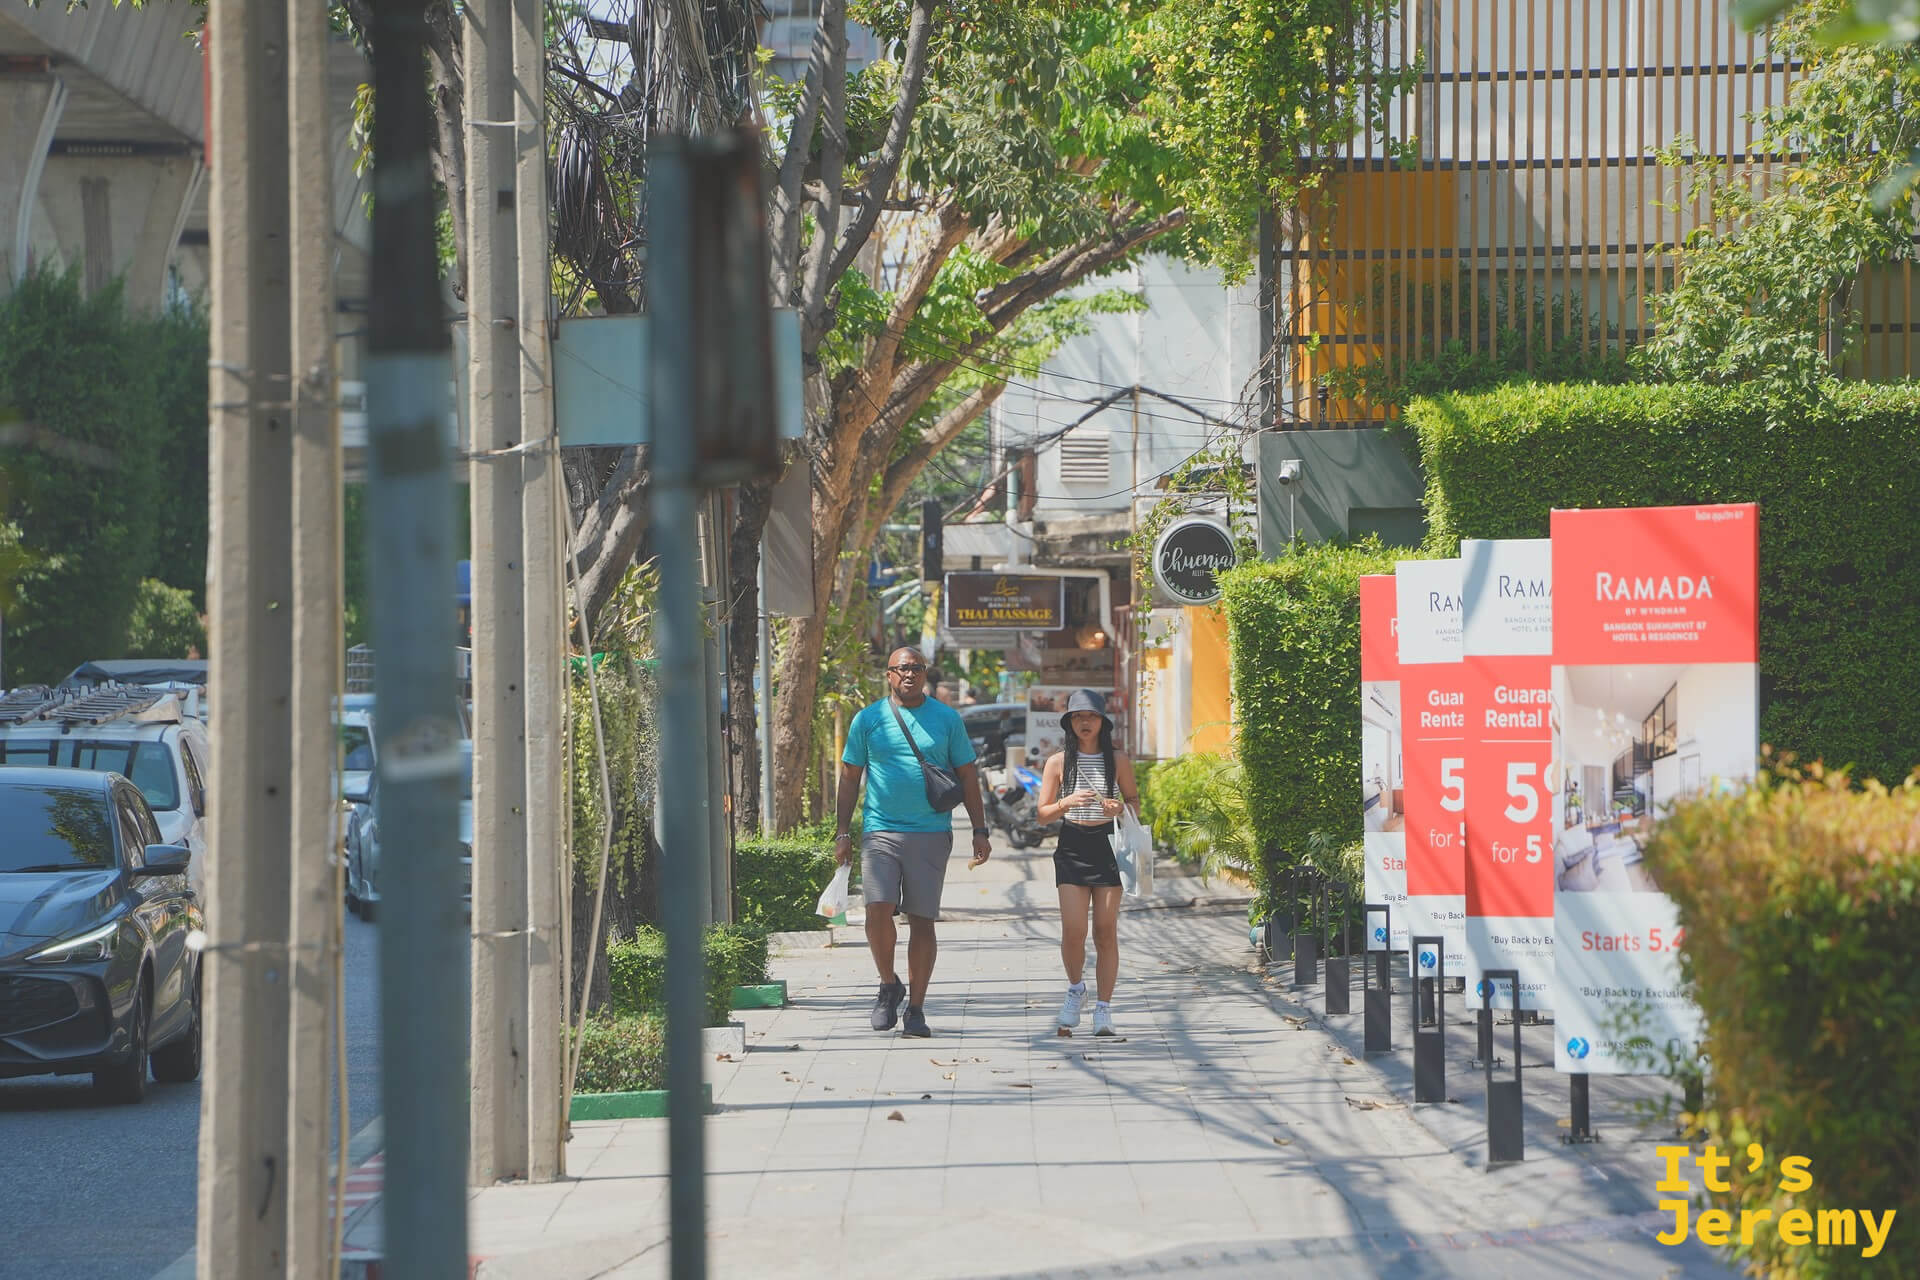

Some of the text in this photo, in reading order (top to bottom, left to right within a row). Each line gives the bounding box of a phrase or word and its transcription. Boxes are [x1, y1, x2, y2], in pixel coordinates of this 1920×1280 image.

[1500, 575, 1552, 598] RAM
[1596, 572, 1713, 601] RAMADA
[957, 608, 1053, 620] THAI MASSAGE
[1640, 606, 1687, 615] WYNDHAM
[1603, 622, 1644, 632] BANGKOK
[1646, 621, 1694, 630] SUKHUMVIT
[1612, 632, 1639, 642] HOTEL
[1648, 632, 1699, 641] RESIDENCES
[1485, 709, 1543, 728] Rental
[1430, 829, 1453, 848] for
[1492, 834, 1542, 863] for 5
[1532, 935, 1542, 945] by
[1582, 931, 1640, 952] Starts
